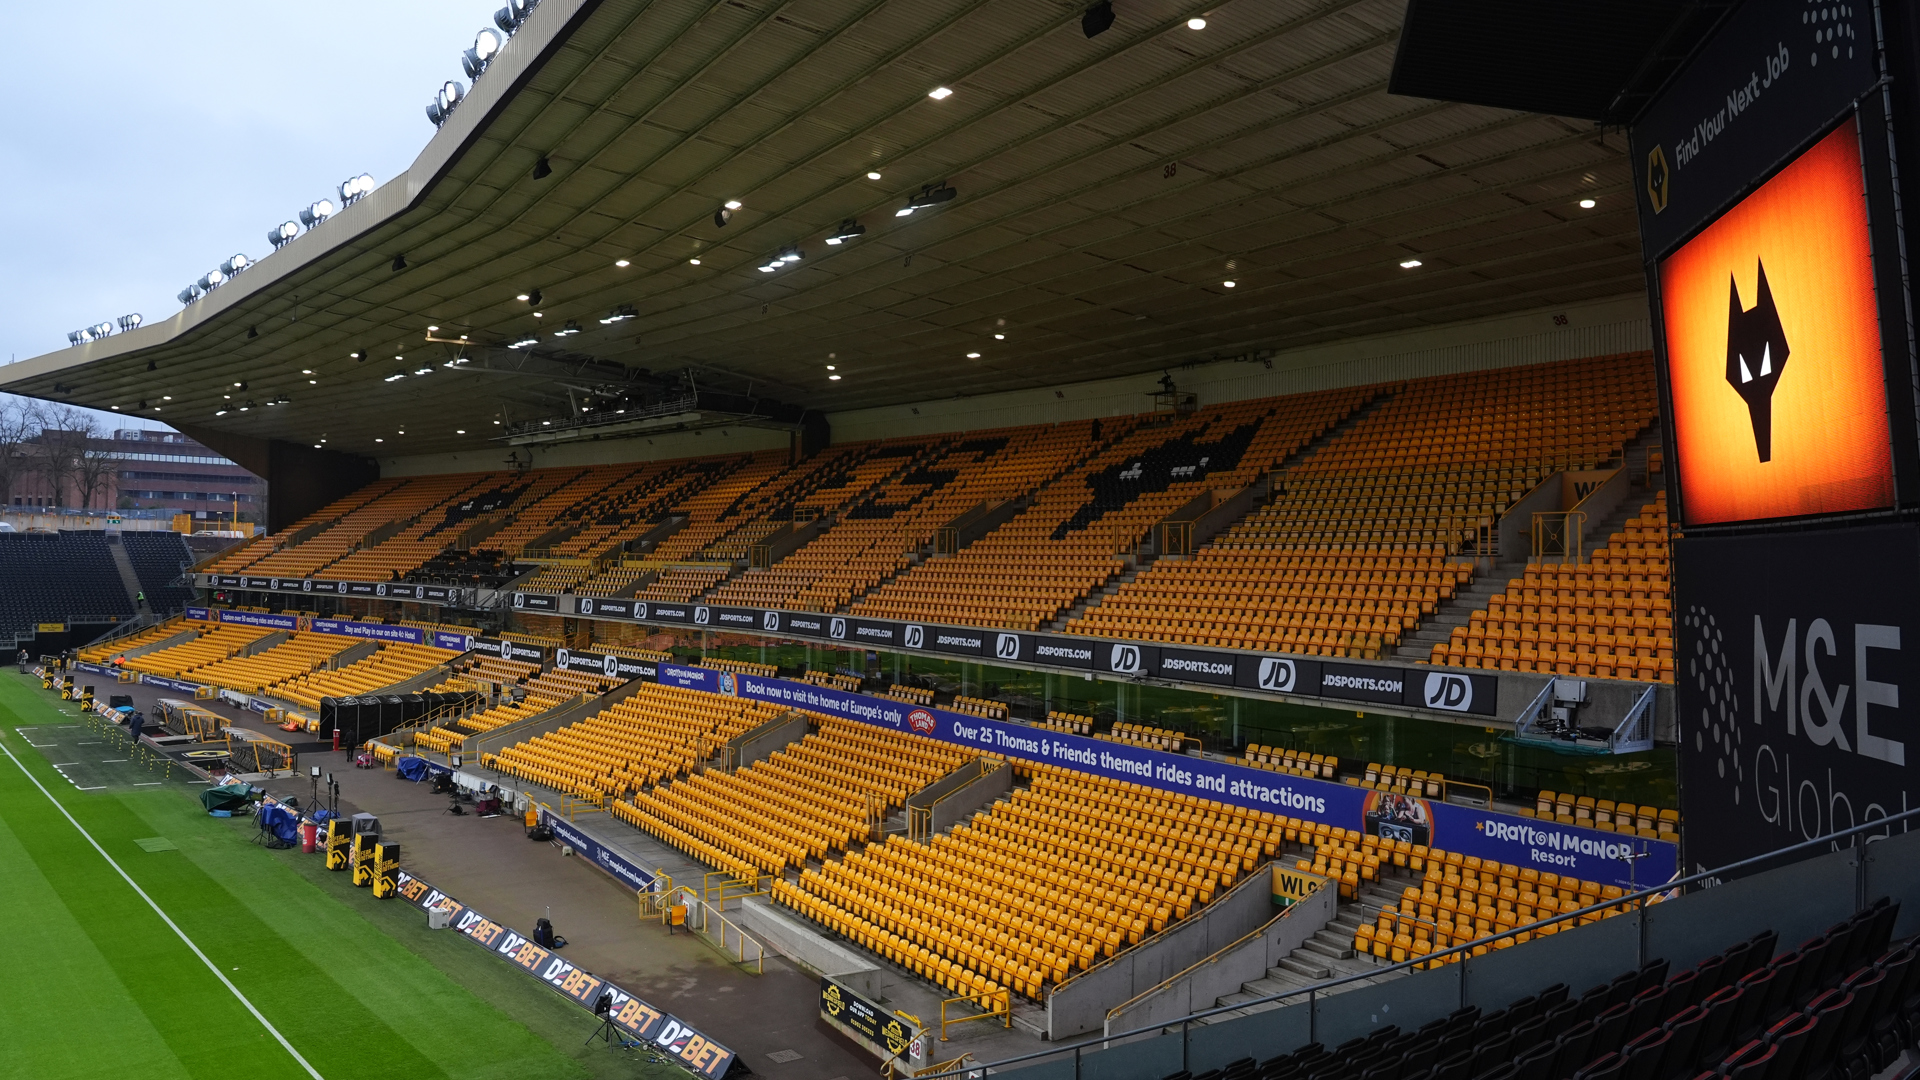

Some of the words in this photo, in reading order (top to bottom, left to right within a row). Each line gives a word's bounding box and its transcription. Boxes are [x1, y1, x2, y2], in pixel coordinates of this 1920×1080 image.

[1676, 123, 1699, 170] Find
[1699, 108, 1725, 147] Your
[1727, 72, 1760, 122] Next
[1763, 42, 1789, 89] Job
[1164, 162, 1176, 179] 38
[1553, 314, 1568, 326] 38
[1574, 481, 1603, 500] W
[345, 625, 353, 634] Stay
[362, 627, 371, 636] Play
[405, 631, 415, 639] Hotel
[466, 638, 473, 649] JD
[475, 641, 500, 651] JDSPORTS.COM
[502, 643, 510, 657] JD
[512, 648, 540, 658] JDSPORTS.COM
[582, 600, 592, 613] JD
[635, 604, 645, 617] JD
[656, 609, 685, 617] JDSPORTS.COM
[696, 608, 707, 622] JD
[719, 614, 753, 623] JDSPORTS.COM
[766, 613, 777, 629] JD
[790, 620, 820, 630] JDSPORTS.COM
[832, 619, 844, 637] JD
[856, 627, 892, 638] JDSPORTS.COM
[907, 627, 921, 646] JD
[936, 635, 981, 648] JDSPORTS.COM
[999, 635, 1018, 657] JD
[1037, 646, 1091, 660] JDSPORTS.COM
[1114, 646, 1138, 671] JD
[1162, 658, 1233, 676] JDSPORTS.COM
[1262, 661, 1292, 689] JD
[1323, 675, 1402, 693] JDSPORTS.COM
[1429, 676, 1467, 707] JD
[559, 653, 567, 665] JD
[569, 656, 602, 668] JDSPORTS.COM
[605, 660, 615, 673] JD
[618, 663, 655, 676] JDSPORTS.COM
[1754, 614, 1905, 766] M&E
[746, 681, 765, 695] Book
[766, 687, 782, 697] now
[783, 689, 791, 699] to
[793, 690, 806, 702] visit
[808, 694, 818, 705] the
[820, 695, 840, 710] home
[841, 699, 850, 712] of
[851, 701, 882, 720] Europe's
[884, 709, 901, 726] only
[910, 711, 935, 727] THOMAS
[915, 720, 928, 730] LAND
[954, 721, 978, 740] Over
[980, 726, 993, 744] 25
[995, 730, 1038, 754] Thomas
[1041, 739, 1050, 756] &
[1053, 741, 1097, 766] Friends
[1100, 752, 1152, 777] themed
[1156, 763, 1192, 786] rides
[1196, 774, 1225, 793] and
[1230, 779, 1325, 814] attractions
[1532, 848, 1576, 868] Resort
[853, 1001, 874, 1016] DOWNLOAD
[865, 1014, 877, 1025] TODAY
[910, 1041, 920, 1056] 38
